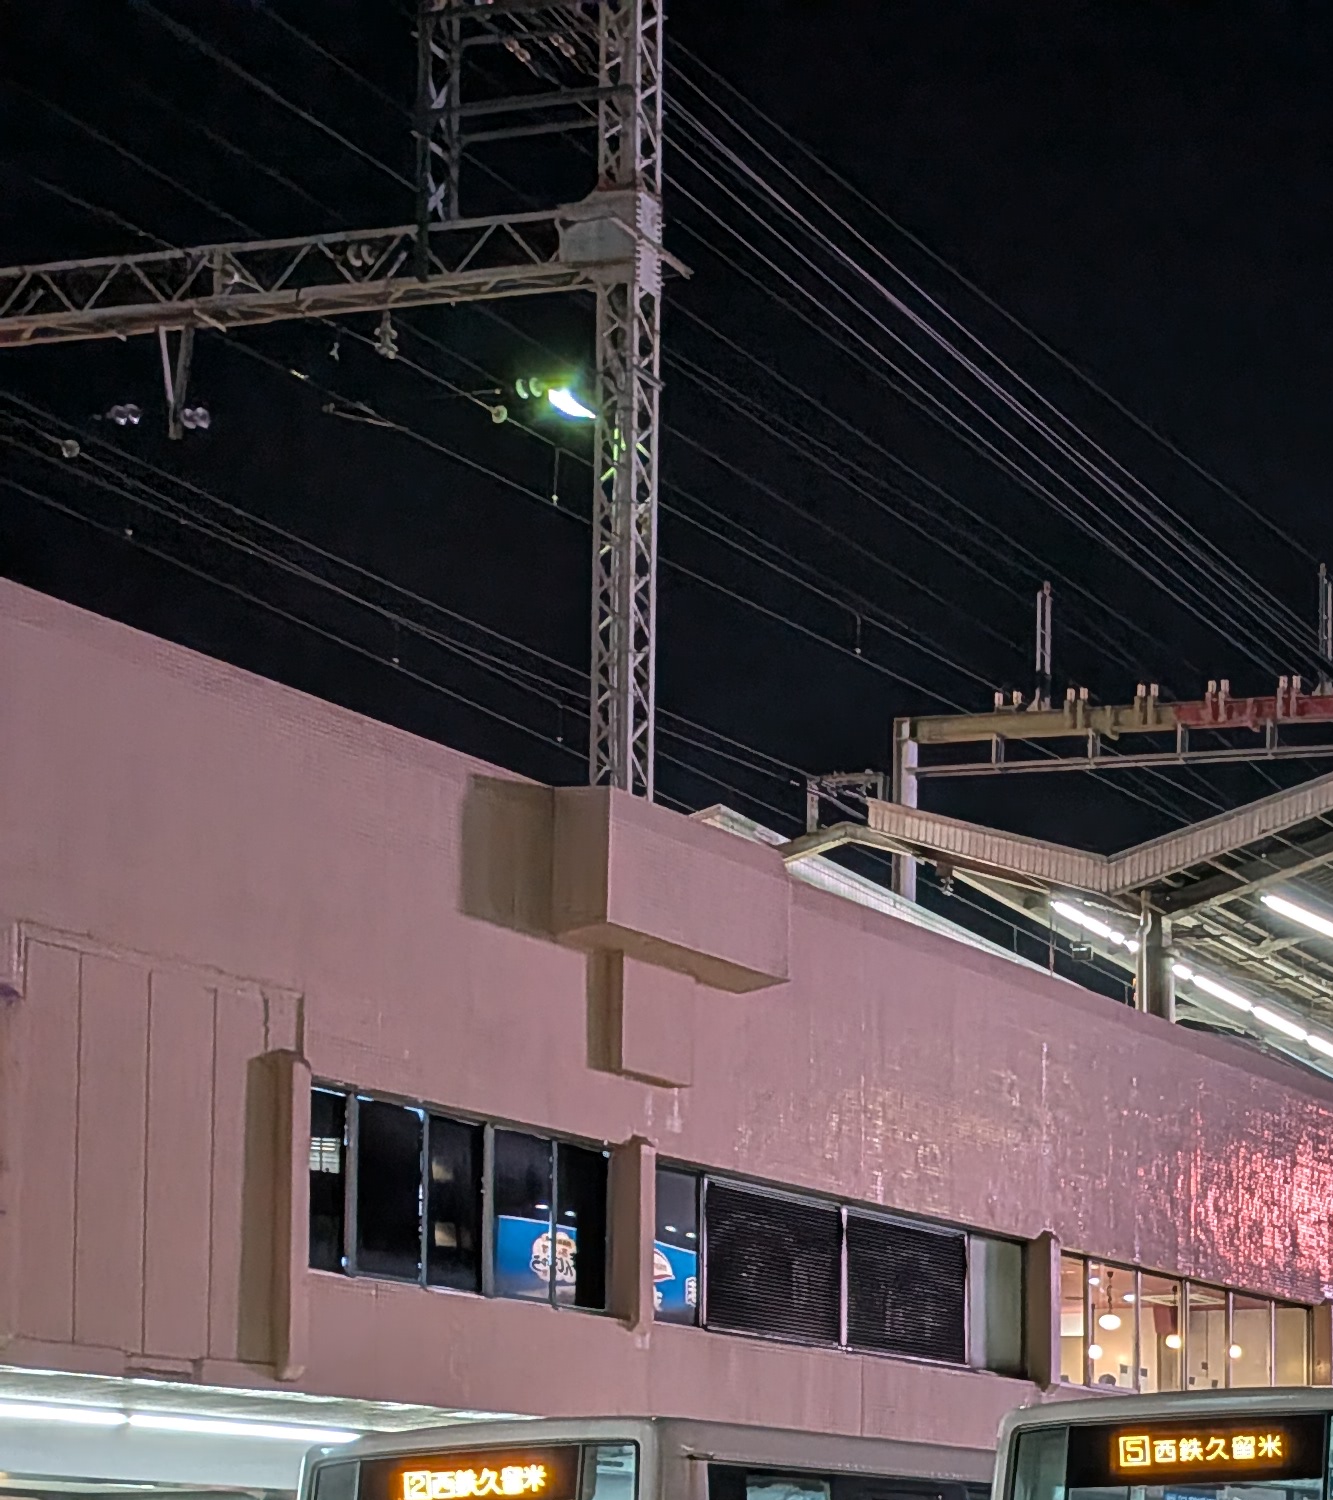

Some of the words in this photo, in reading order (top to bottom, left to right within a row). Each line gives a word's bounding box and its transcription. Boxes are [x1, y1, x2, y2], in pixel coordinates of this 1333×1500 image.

[1152, 1434, 1283, 1463] 西鉄久留米
[432, 1464, 548, 1499] 西鉄久留米
